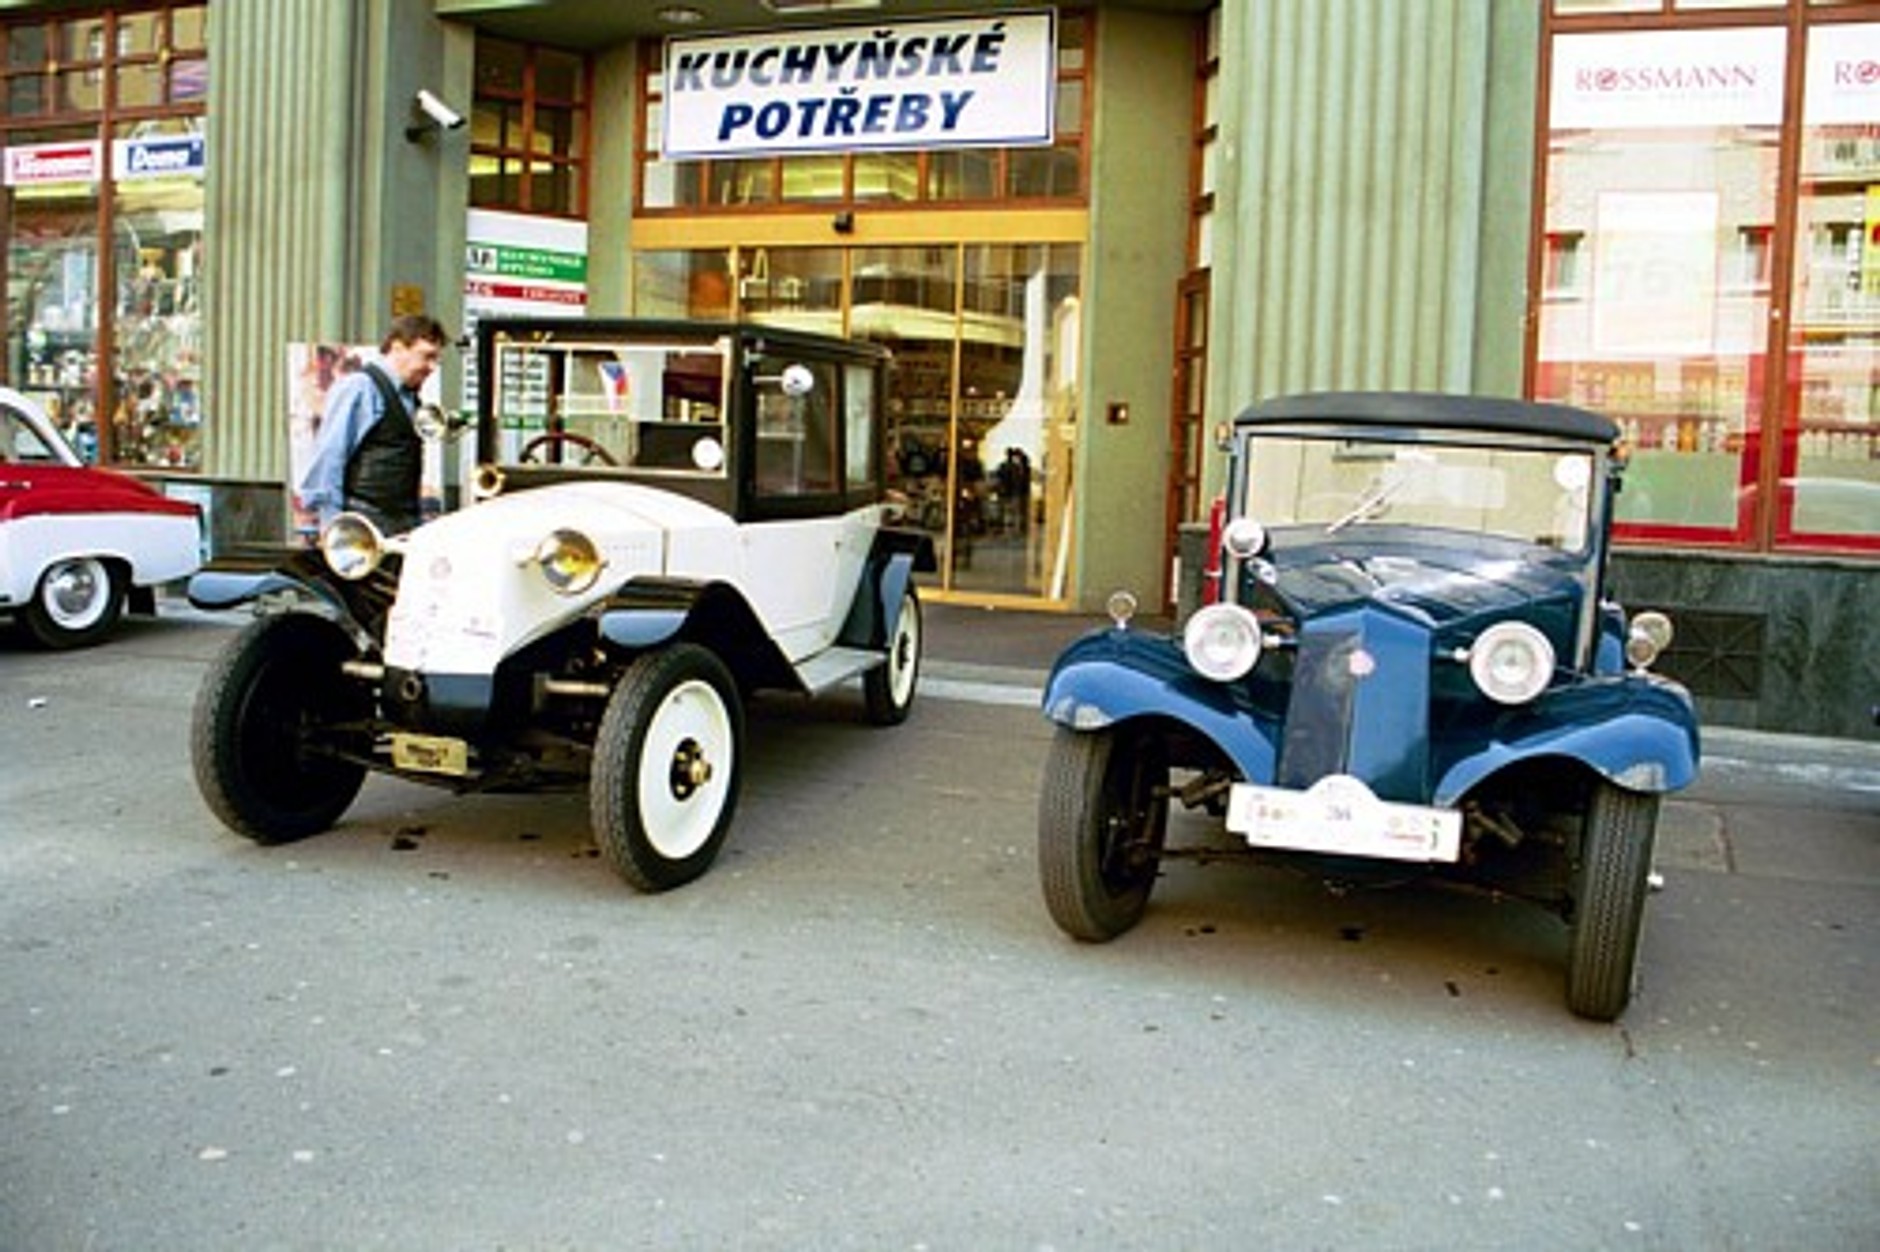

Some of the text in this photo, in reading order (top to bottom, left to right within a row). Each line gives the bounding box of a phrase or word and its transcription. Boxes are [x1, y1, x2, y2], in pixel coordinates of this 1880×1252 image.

[673, 22, 1006, 91] KUCHYŇSKÉ
[1575, 65, 1758, 91] ROSSMANN
[717, 87, 975, 141] POTŘEBY
